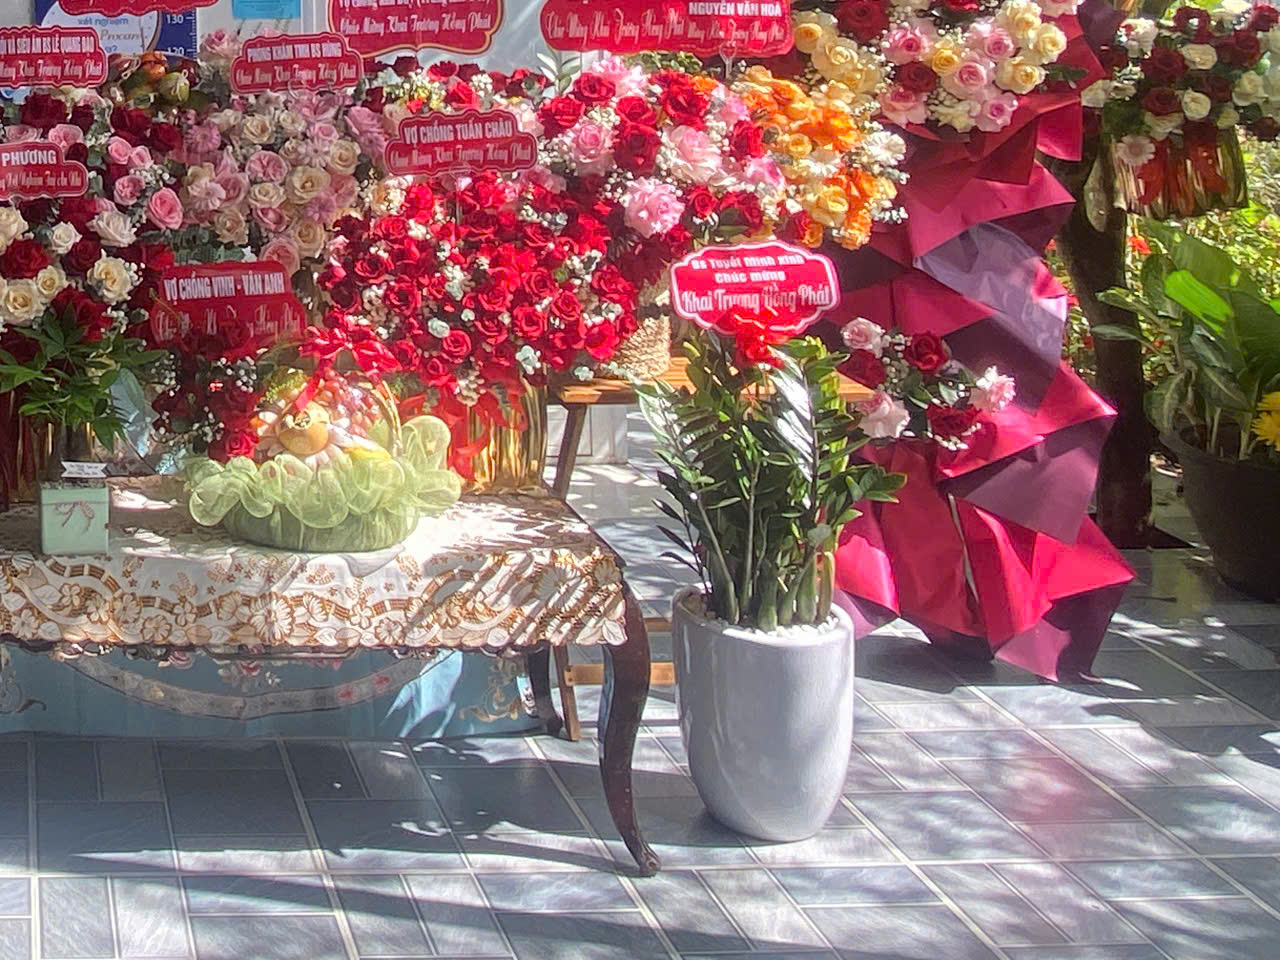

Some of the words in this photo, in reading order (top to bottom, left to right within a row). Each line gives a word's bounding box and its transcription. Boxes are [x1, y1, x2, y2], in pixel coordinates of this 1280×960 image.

[736, 1, 759, 16] VĂN
[166, 16, 184, 24] 130
[1, 149, 56, 167] PHƯƠNG
[164, 277, 177, 305] VỢ
[179, 271, 212, 300] CHỒNG
[212, 276, 236, 297] VINH
[264, 272, 285, 294] ANH
[682, 290, 713, 313] Khai
[798, 283, 830, 306] Phát
